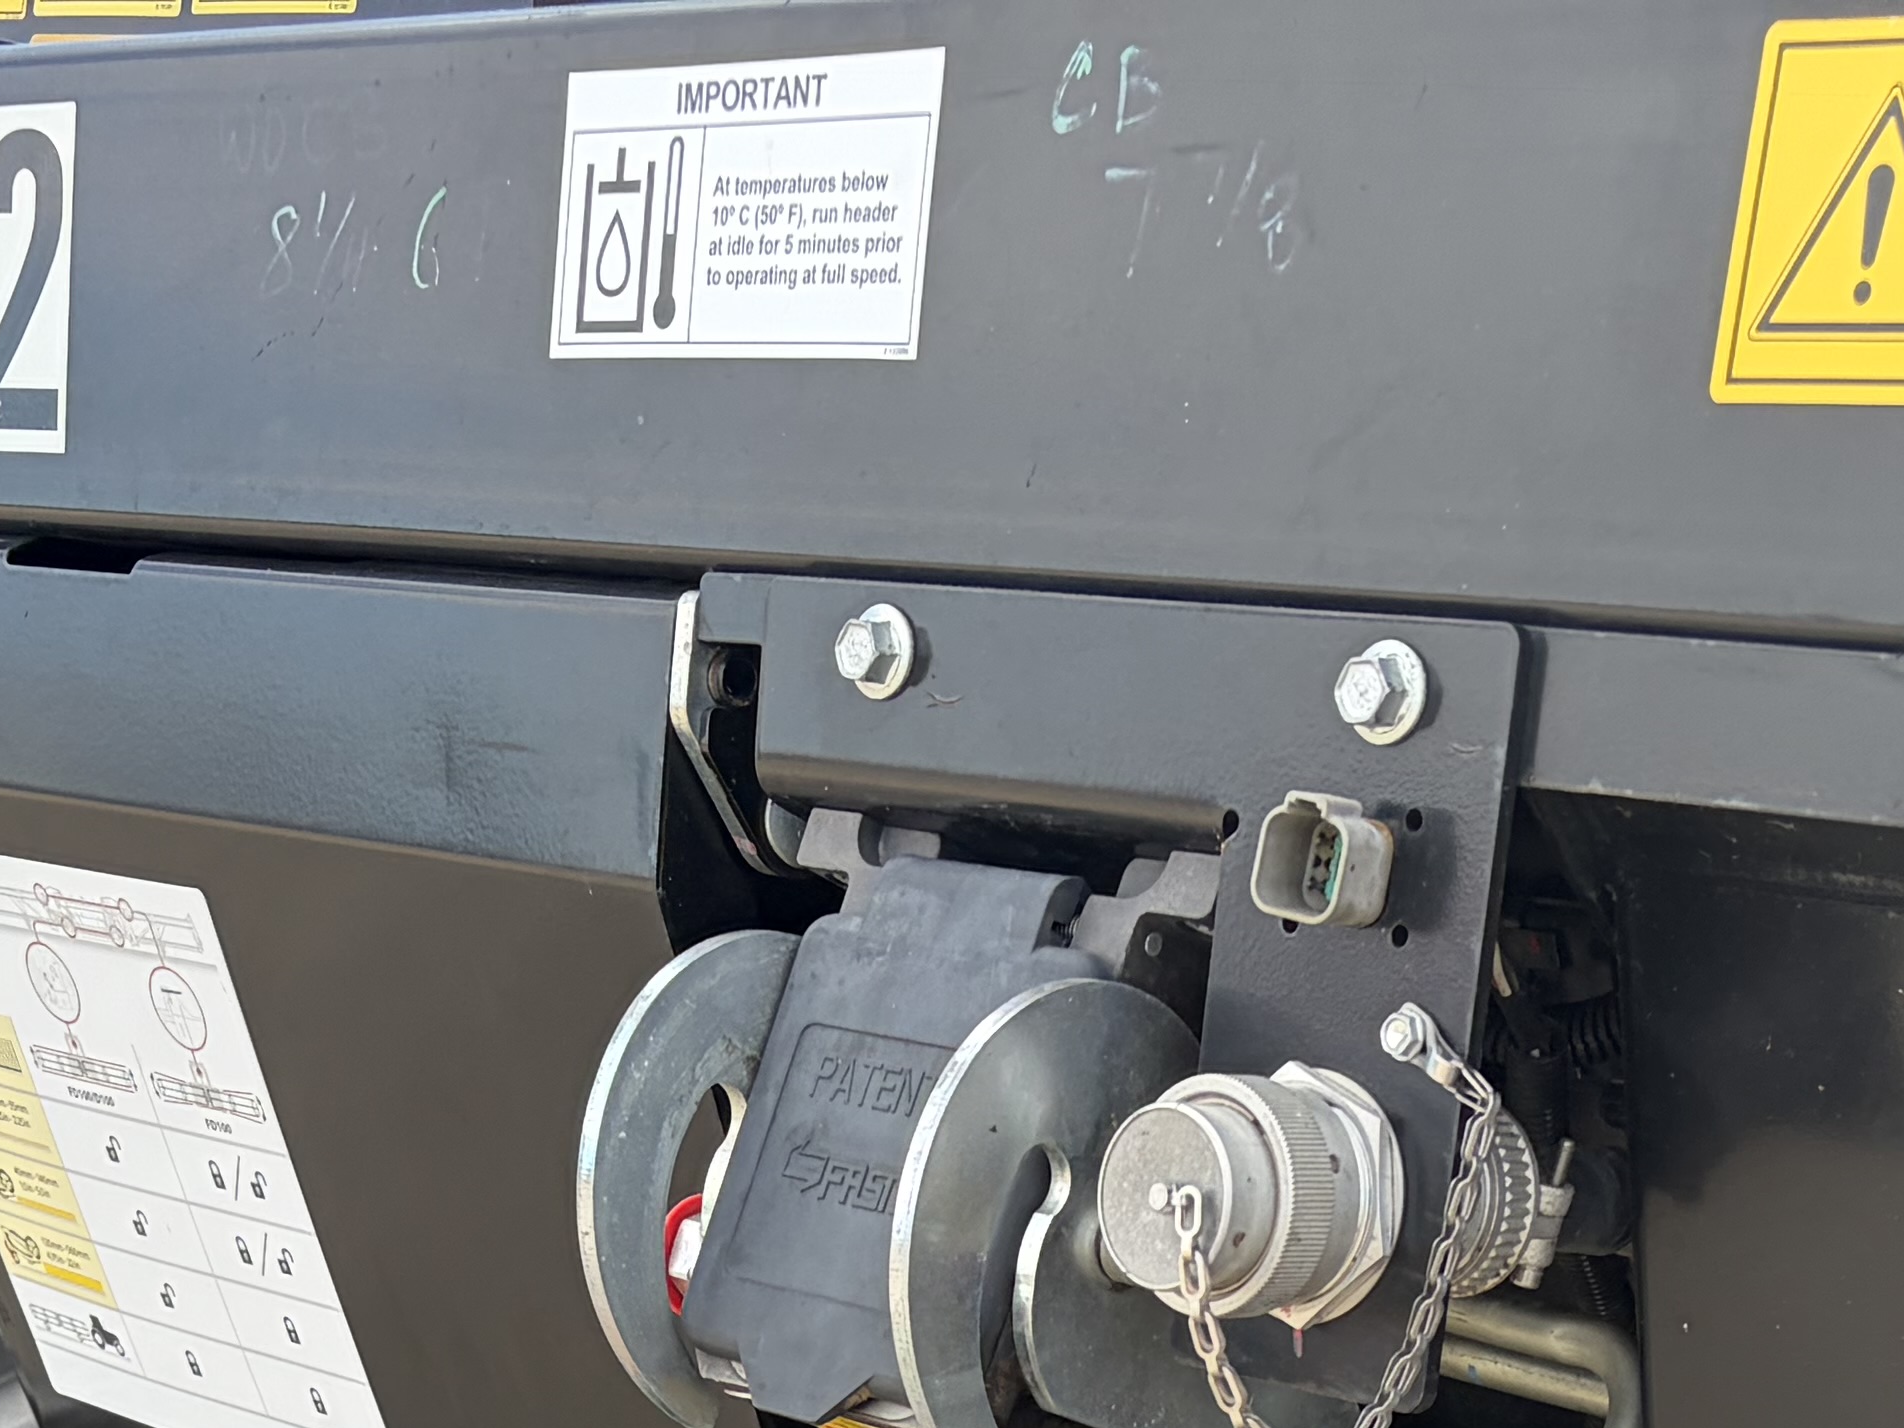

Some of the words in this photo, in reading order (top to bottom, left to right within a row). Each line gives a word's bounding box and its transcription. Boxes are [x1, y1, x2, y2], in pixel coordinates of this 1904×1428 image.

[675, 73, 828, 115] IMPORTANT
[712, 175, 732, 197] At
[735, 172, 837, 199] temperatures
[841, 171, 889, 193] below
[739, 204, 750, 225] C
[787, 202, 807, 229] F),
[811, 207, 838, 225] run
[843, 201, 899, 223] header
[708, 237, 723, 257] at
[727, 234, 754, 256] idle
[758, 233, 780, 256] for
[784, 234, 794, 256] 5
[798, 232, 860, 255] minutes
[865, 231, 903, 259] prior
[706, 266, 722, 286] to
[725, 265, 798, 291] operating
[802, 265, 818, 285] at
[821, 263, 846, 284] full
[850, 262, 902, 289] speed.
